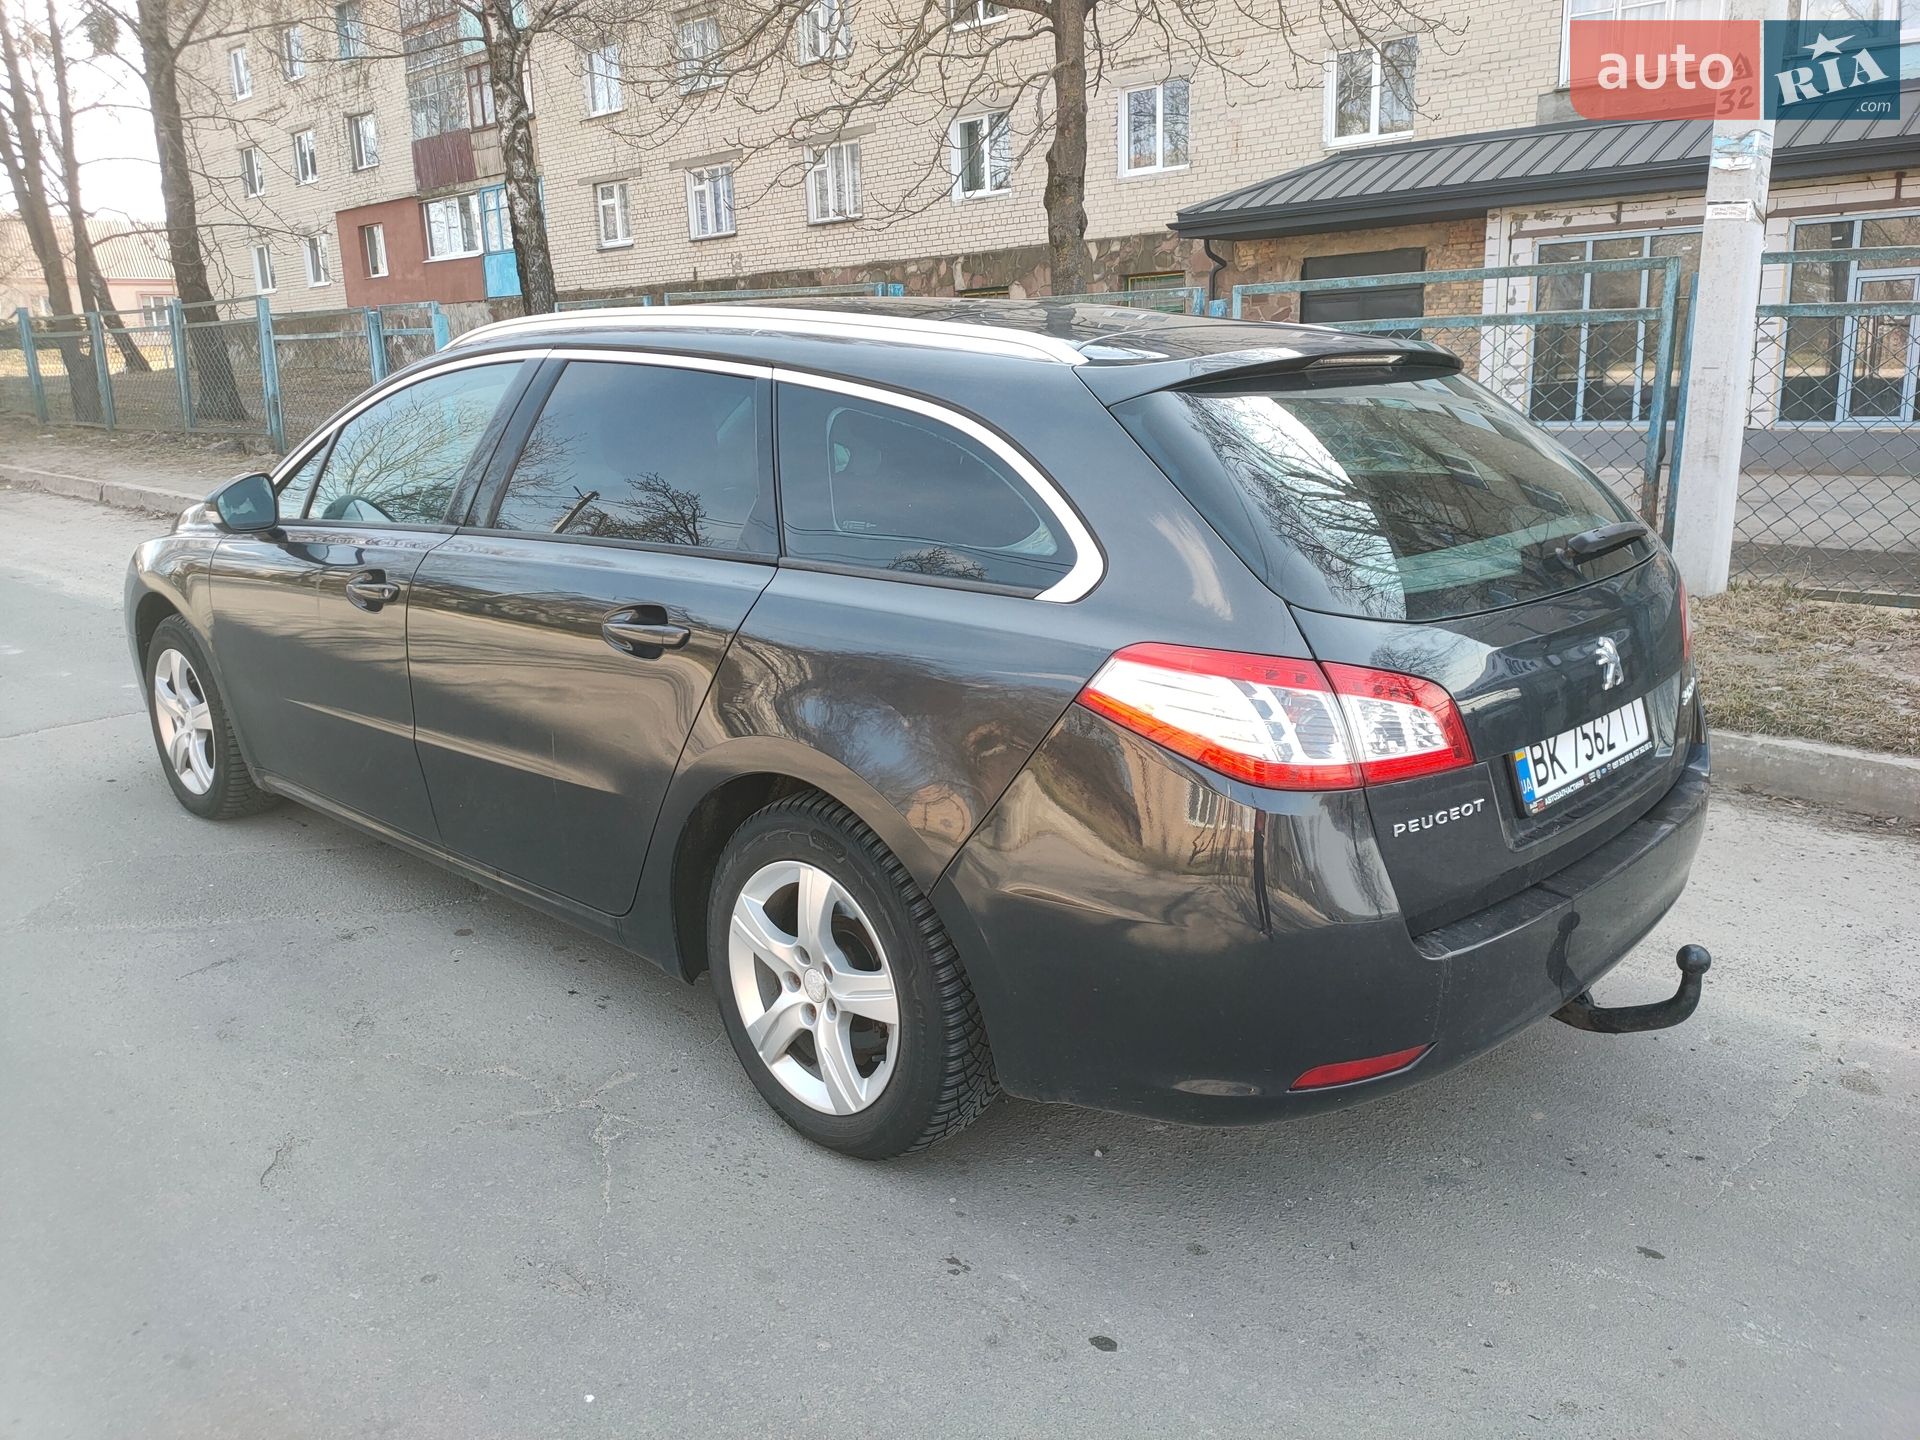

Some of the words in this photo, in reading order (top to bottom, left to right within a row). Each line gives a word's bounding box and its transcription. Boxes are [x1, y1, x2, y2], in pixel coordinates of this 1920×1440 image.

[1717, 85, 1755, 115] 32
[1529, 735, 1568, 788] BK
[1573, 714, 1616, 769] 7562
[1393, 798, 1485, 838] PEUGEOT
